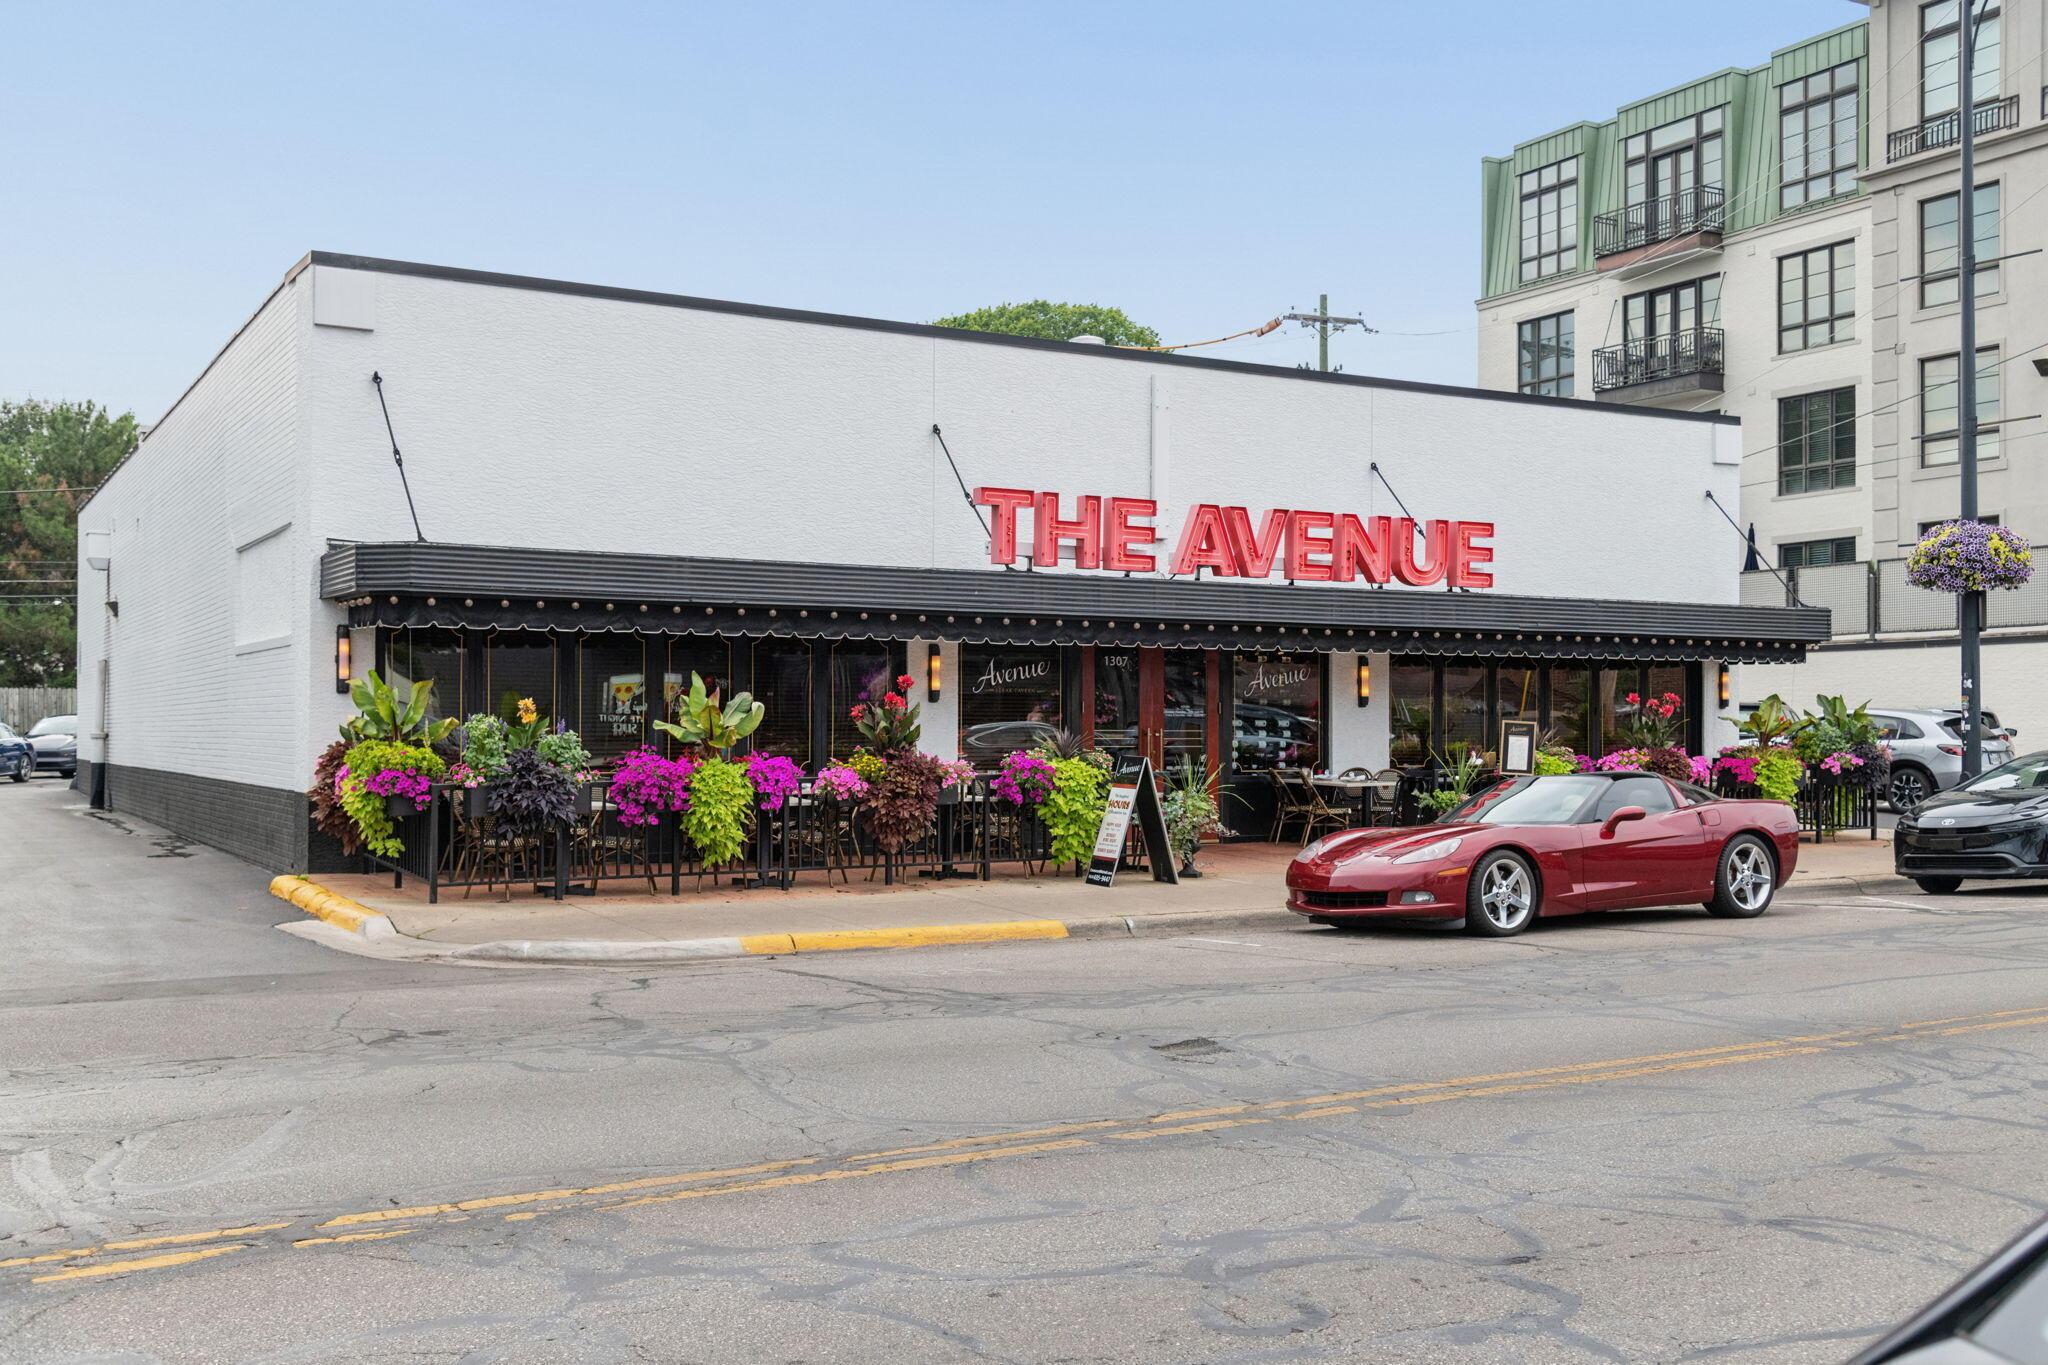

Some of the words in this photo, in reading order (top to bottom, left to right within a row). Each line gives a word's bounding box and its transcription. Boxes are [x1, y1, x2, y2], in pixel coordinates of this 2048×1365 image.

[973, 487, 1158, 572] THE
[1169, 504, 1495, 588] AVENUE
[972, 657, 1051, 694] Avenue
[1104, 655, 1129, 667] 1307
[1243, 664, 1311, 697] Avenue
